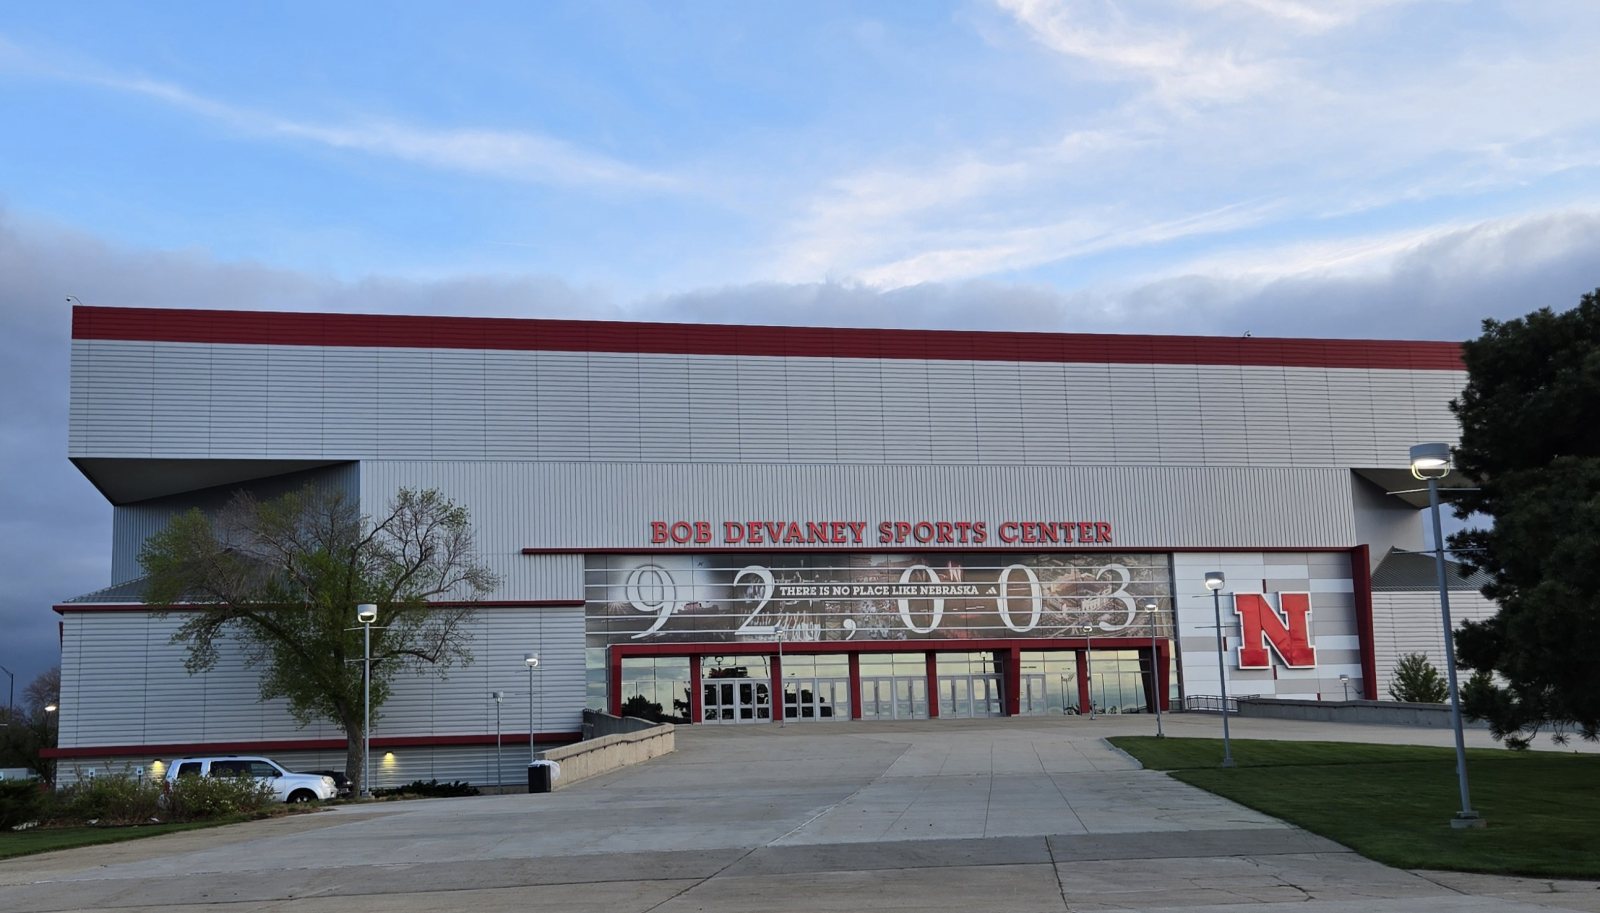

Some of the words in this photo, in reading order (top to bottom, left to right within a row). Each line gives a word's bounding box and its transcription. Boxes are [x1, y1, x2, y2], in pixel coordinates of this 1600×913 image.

[651, 521, 712, 543] BOB
[723, 521, 867, 543] DEVANEY
[879, 521, 987, 543] SPORTS
[999, 521, 1112, 543] CENTER
[780, 586, 817, 596] THERE
[819, 586, 830, 596] IS
[832, 586, 850, 596] NO
[852, 586, 890, 596] PLACE
[891, 586, 918, 595] LIKE
[920, 585, 979, 595] NEBRASKA
[1231, 590, 1317, 670] N
